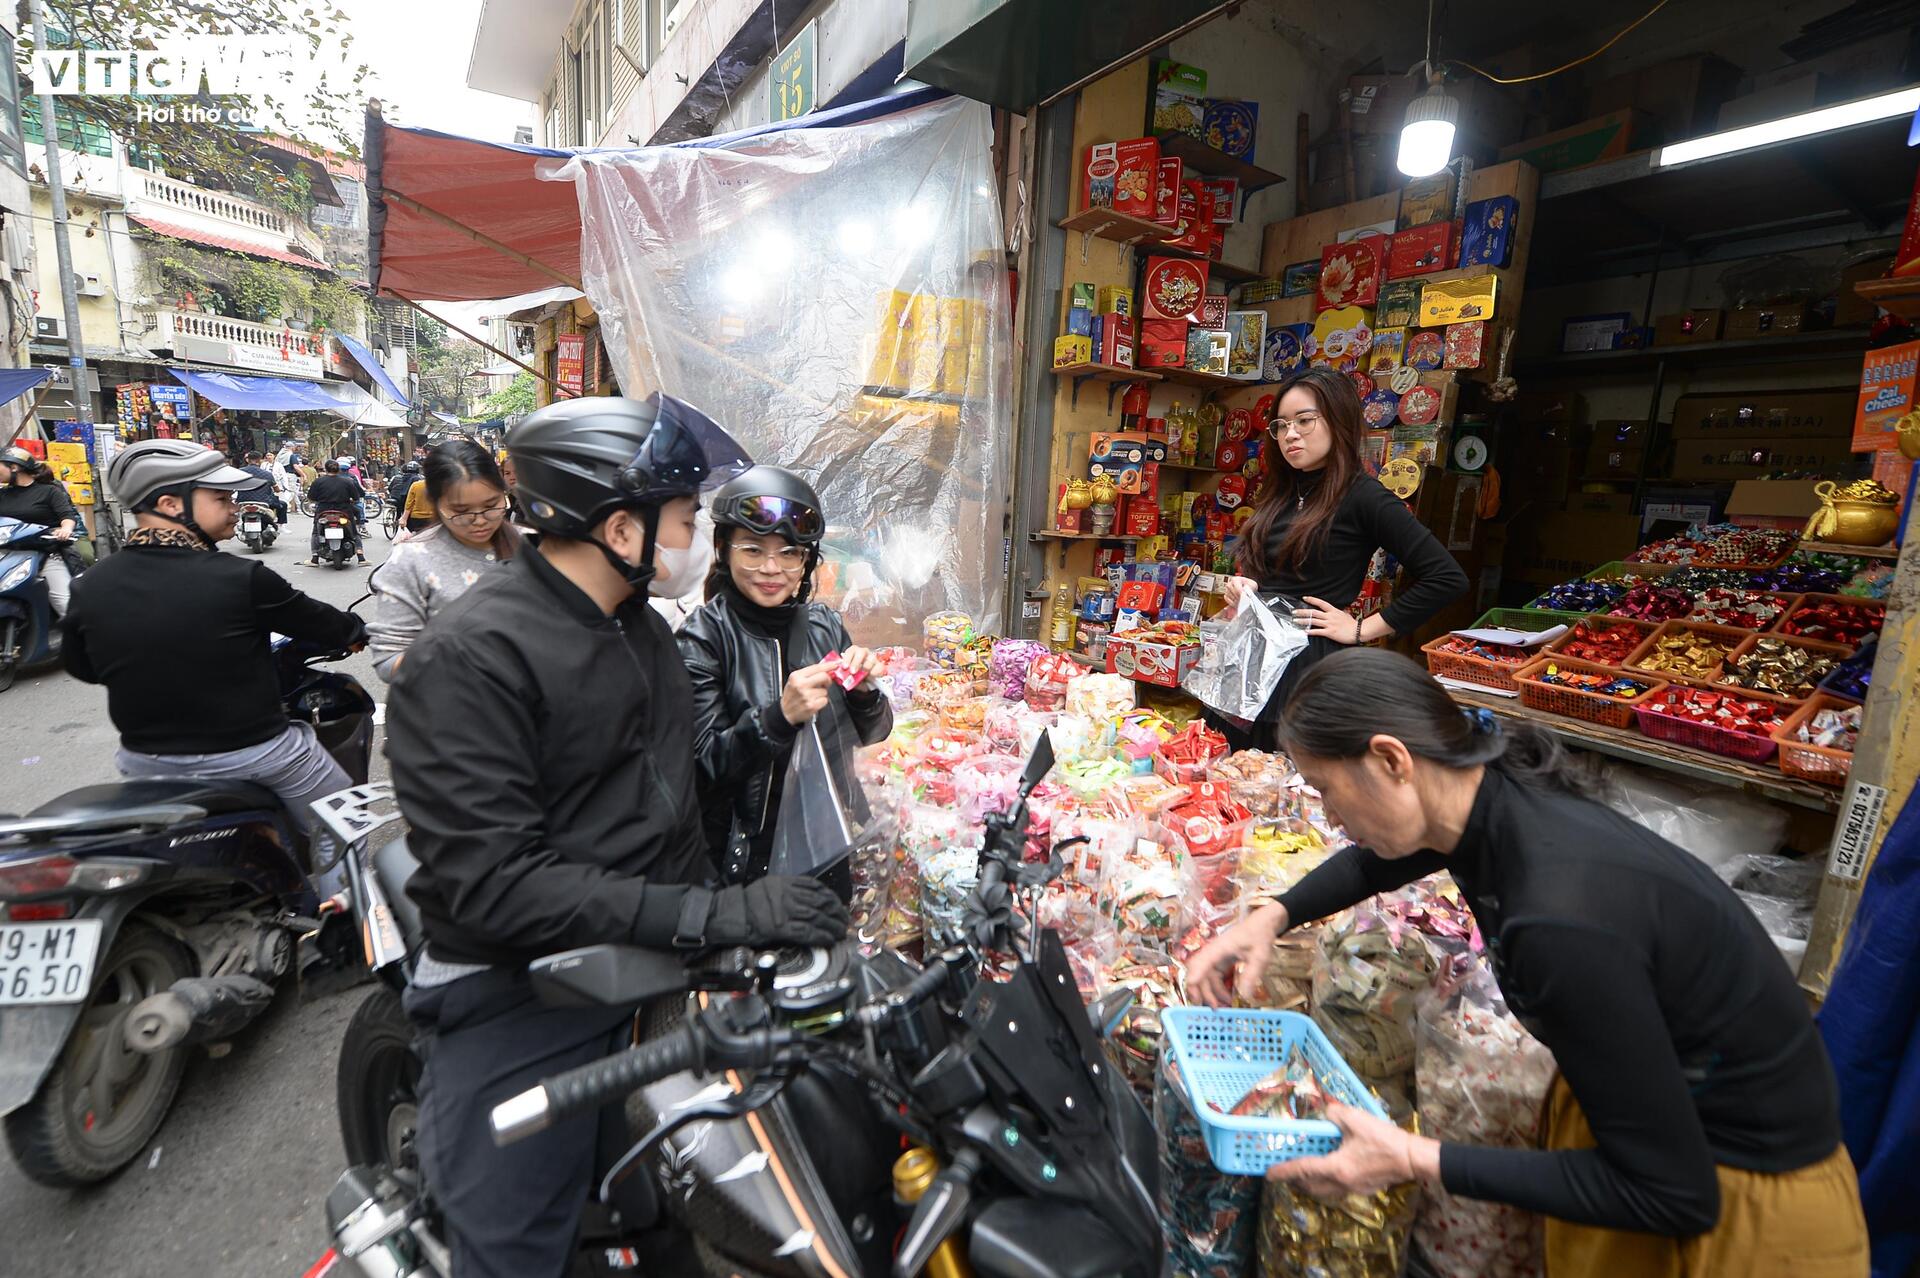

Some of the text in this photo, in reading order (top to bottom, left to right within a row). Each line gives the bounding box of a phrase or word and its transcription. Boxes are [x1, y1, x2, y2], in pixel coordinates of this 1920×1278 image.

[779, 64, 803, 121] 15
[1878, 384, 1899, 401] Cal
[1863, 393, 1907, 413] Cheese
[1131, 513, 1155, 521] TOFFEE
[1837, 803, 1868, 865] 0375637123
